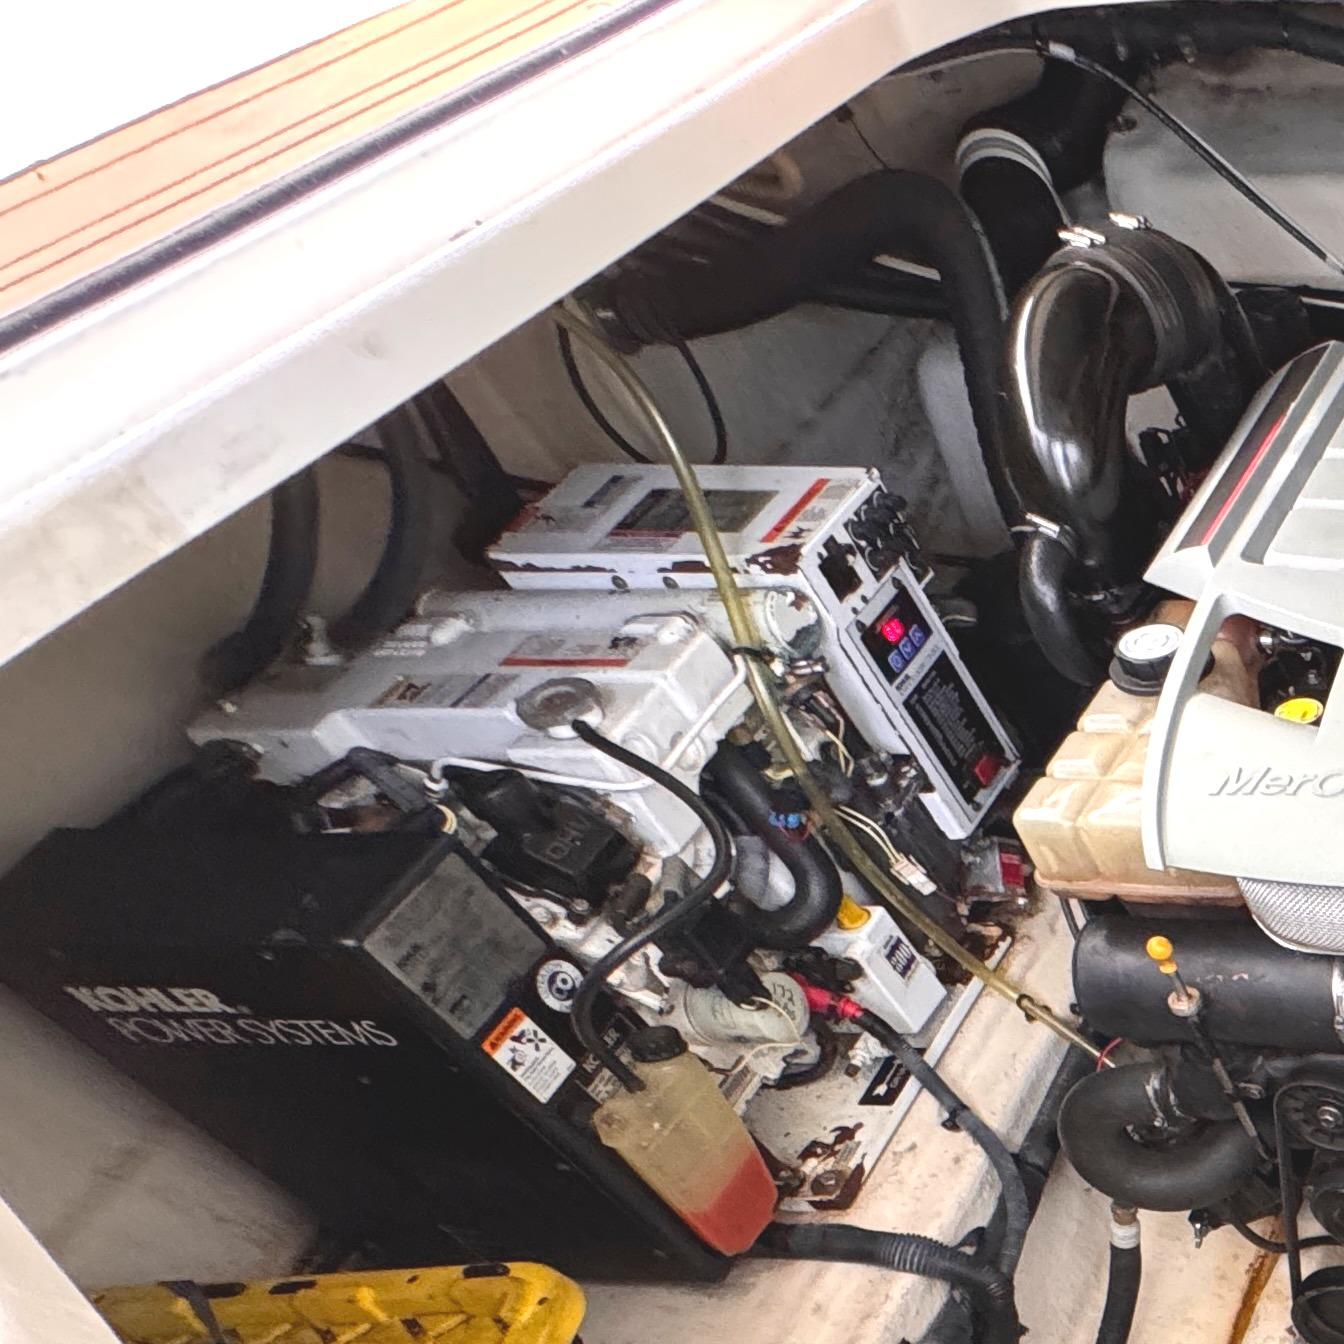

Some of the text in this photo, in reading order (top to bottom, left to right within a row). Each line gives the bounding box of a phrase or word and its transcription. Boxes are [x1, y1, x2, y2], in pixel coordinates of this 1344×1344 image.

[63, 985, 239, 1014] KOHLER
[107, 1017, 399, 1047] POWER SYSTEMS
